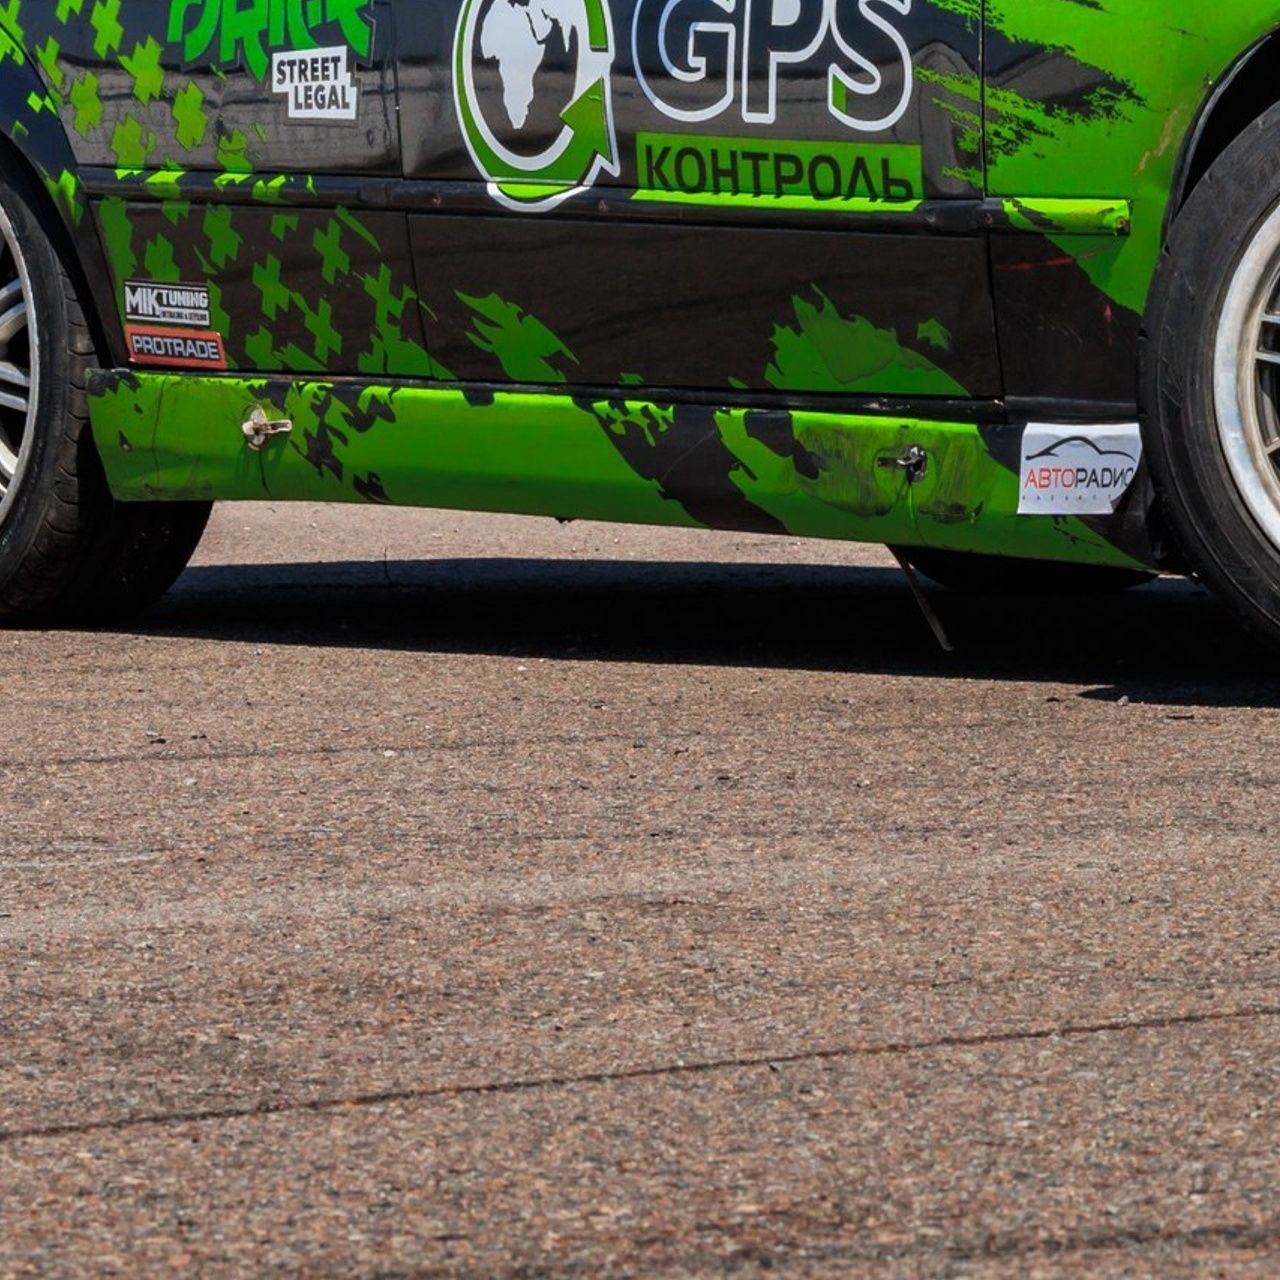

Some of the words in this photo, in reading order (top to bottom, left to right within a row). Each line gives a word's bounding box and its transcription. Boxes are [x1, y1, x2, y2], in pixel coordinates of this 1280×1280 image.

[275, 56, 342, 85] STREET
[293, 85, 351, 111] LEGAL
[644, 145, 915, 204] КОНТРОЛЬ
[131, 335, 220, 360] PROTRADE
